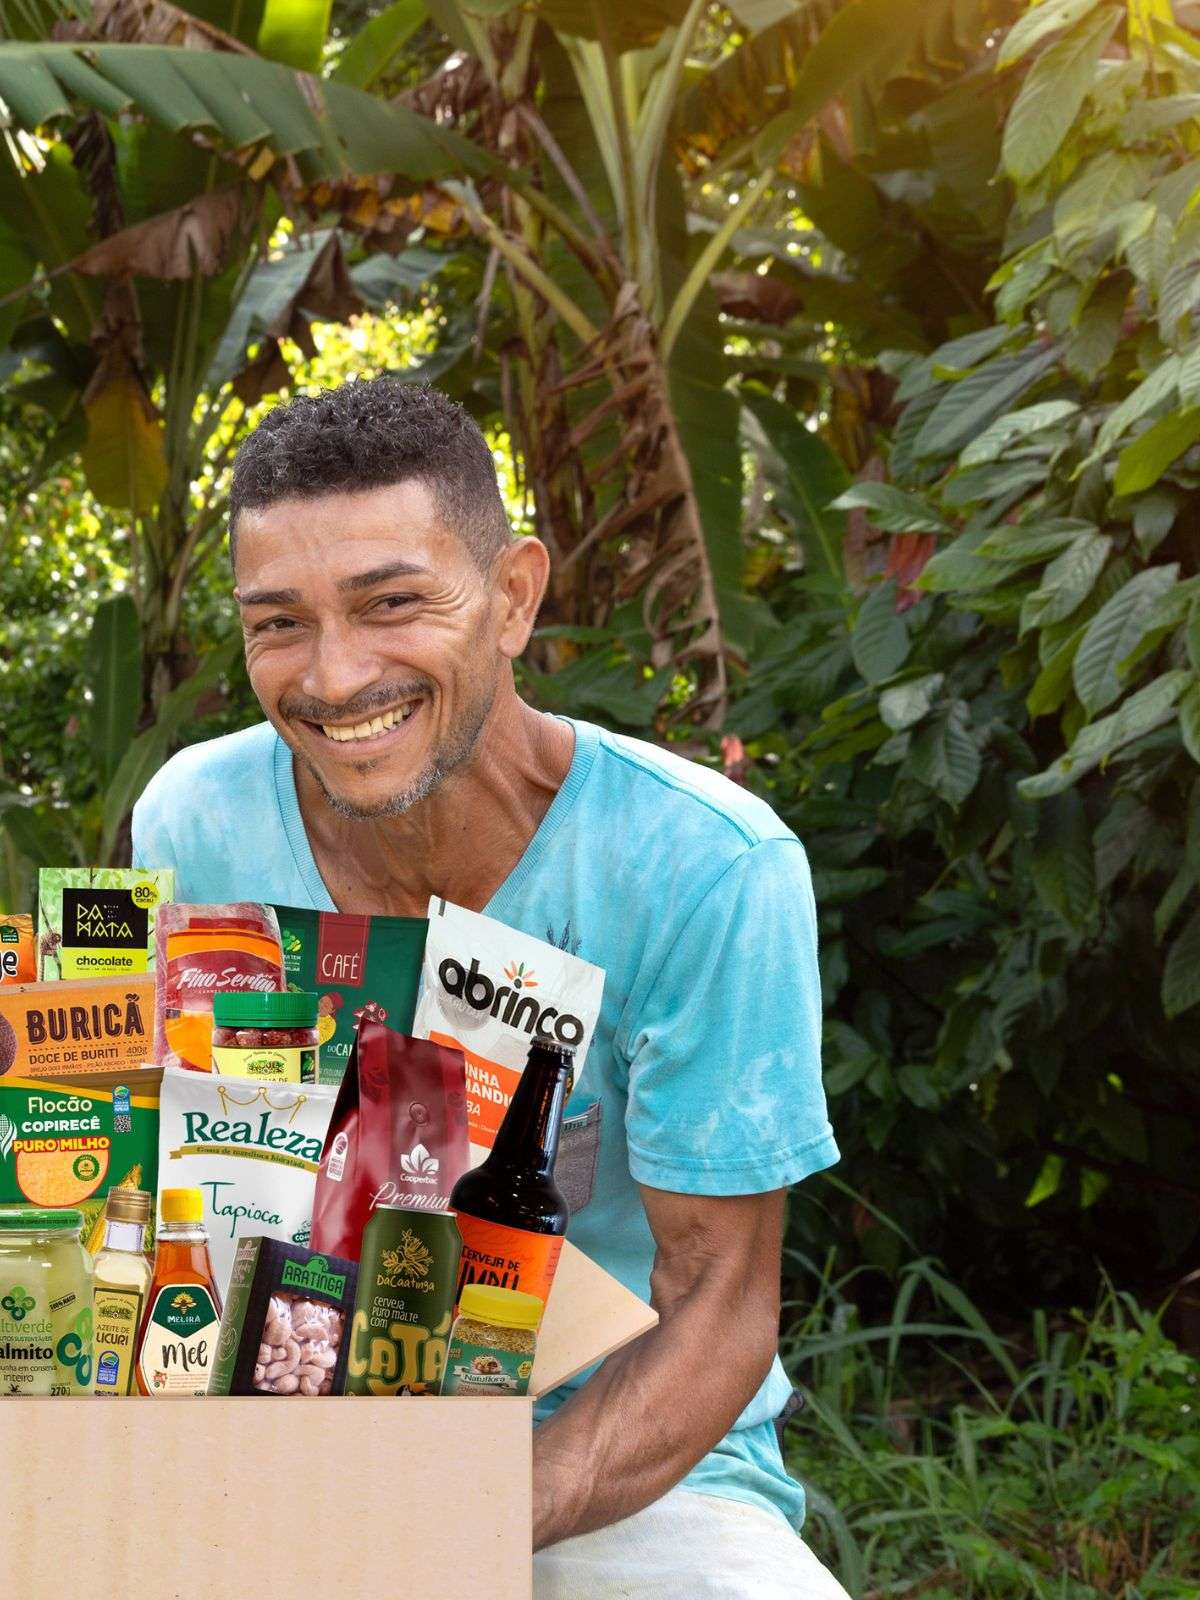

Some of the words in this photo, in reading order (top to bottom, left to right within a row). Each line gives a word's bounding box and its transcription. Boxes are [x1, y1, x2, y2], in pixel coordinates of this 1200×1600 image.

[135, 887, 157, 898] 80%
[77, 903, 104, 920] DA
[76, 921, 133, 938] MATA
[76, 956, 133, 967] chocolate
[321, 952, 360, 980] CAFÉ
[176, 967, 218, 990] Fino
[438, 957, 584, 1047] abrinco
[27, 993, 145, 1045] BURICÃ
[29, 1052, 60, 1065] DOCE
[64, 1051, 78, 1062] DE
[81, 1048, 118, 1060] BURITI
[465, 1061, 500, 1088] INHA
[28, 1096, 92, 1114] Flocão
[21, 1116, 100, 1132] COPIRECÊ
[13, 1138, 57, 1153] PURO
[60, 1136, 110, 1150] MILHO
[182, 1111, 323, 1163] Realeza
[200, 1182, 282, 1238] Tapioca
[462, 1246, 504, 1268] CERVEJA
[508, 1260, 520, 1272] DE
[284, 1265, 342, 1295] ARATINGA
[374, 1296, 405, 1310] cerveja
[96, 1324, 120, 1334] AZEITE
[121, 1326, 130, 1334] DE
[370, 1316, 388, 1328] com
[96, 1332, 129, 1346] LICURI
[4, 1373, 34, 1382] inteiro
